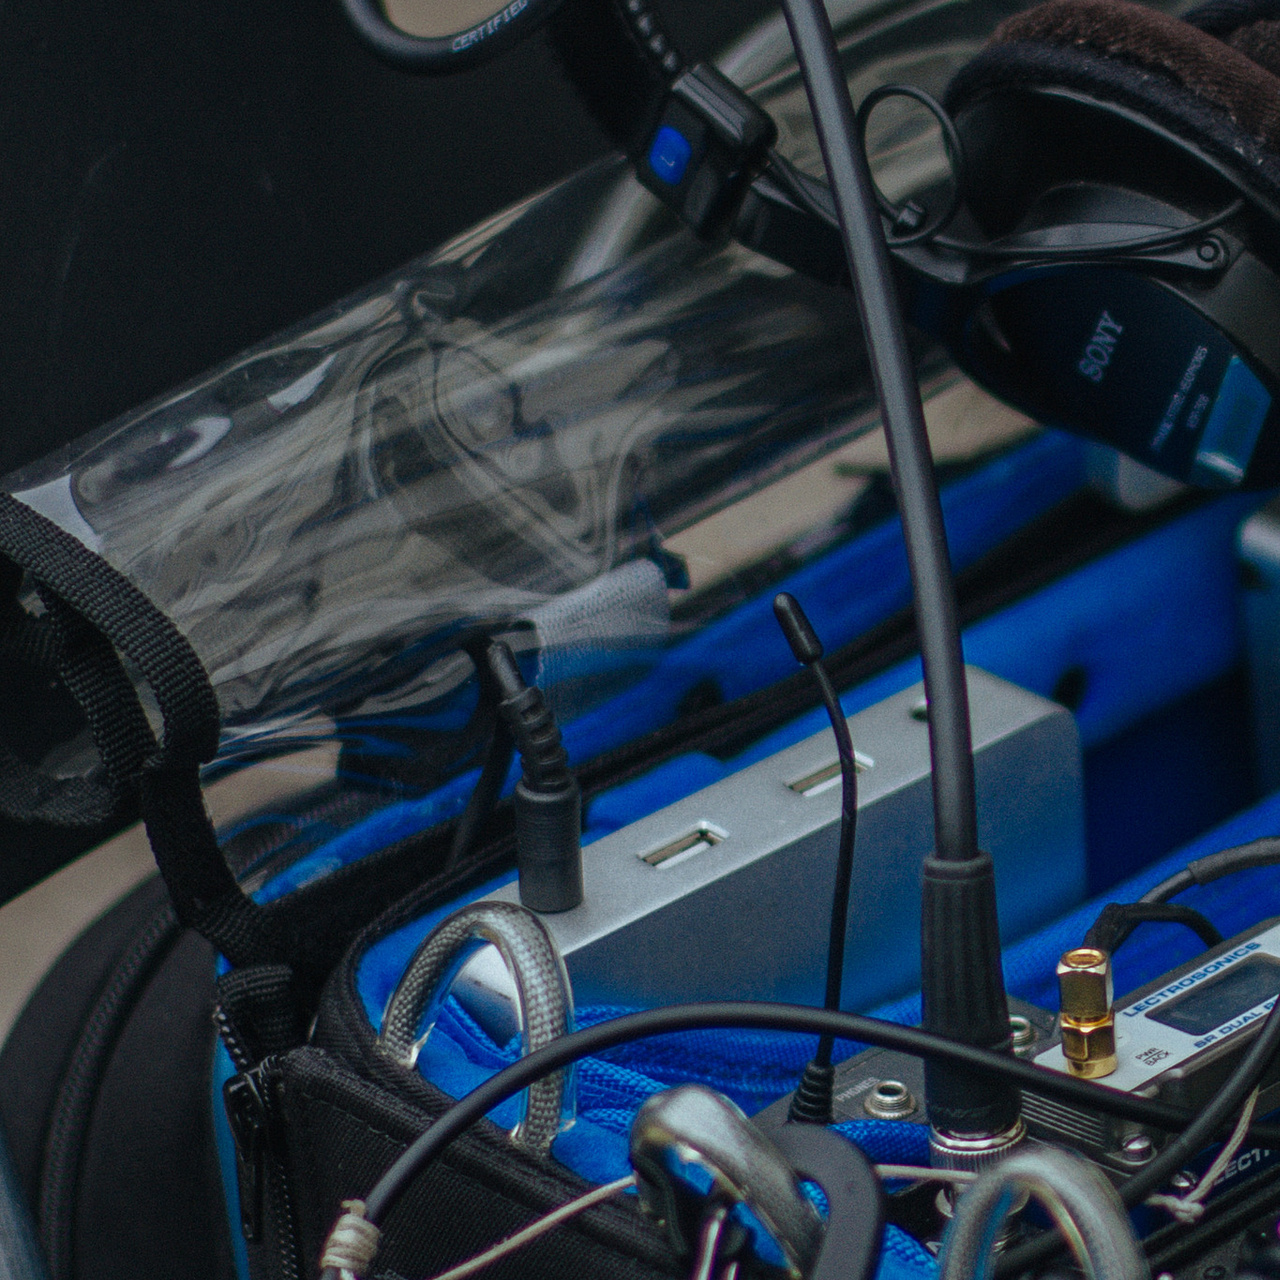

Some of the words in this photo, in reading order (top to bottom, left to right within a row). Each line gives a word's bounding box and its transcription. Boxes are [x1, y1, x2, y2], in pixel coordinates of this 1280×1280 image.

[1079, 310, 1124, 383] SONY
[1122, 941, 1262, 1018] LECTROSONICS
[1193, 1034, 1218, 1049] SR
[1220, 1010, 1263, 1036] DUAL
[1135, 1046, 1159, 1061] PWR
[1144, 1049, 1172, 1067] BACK
